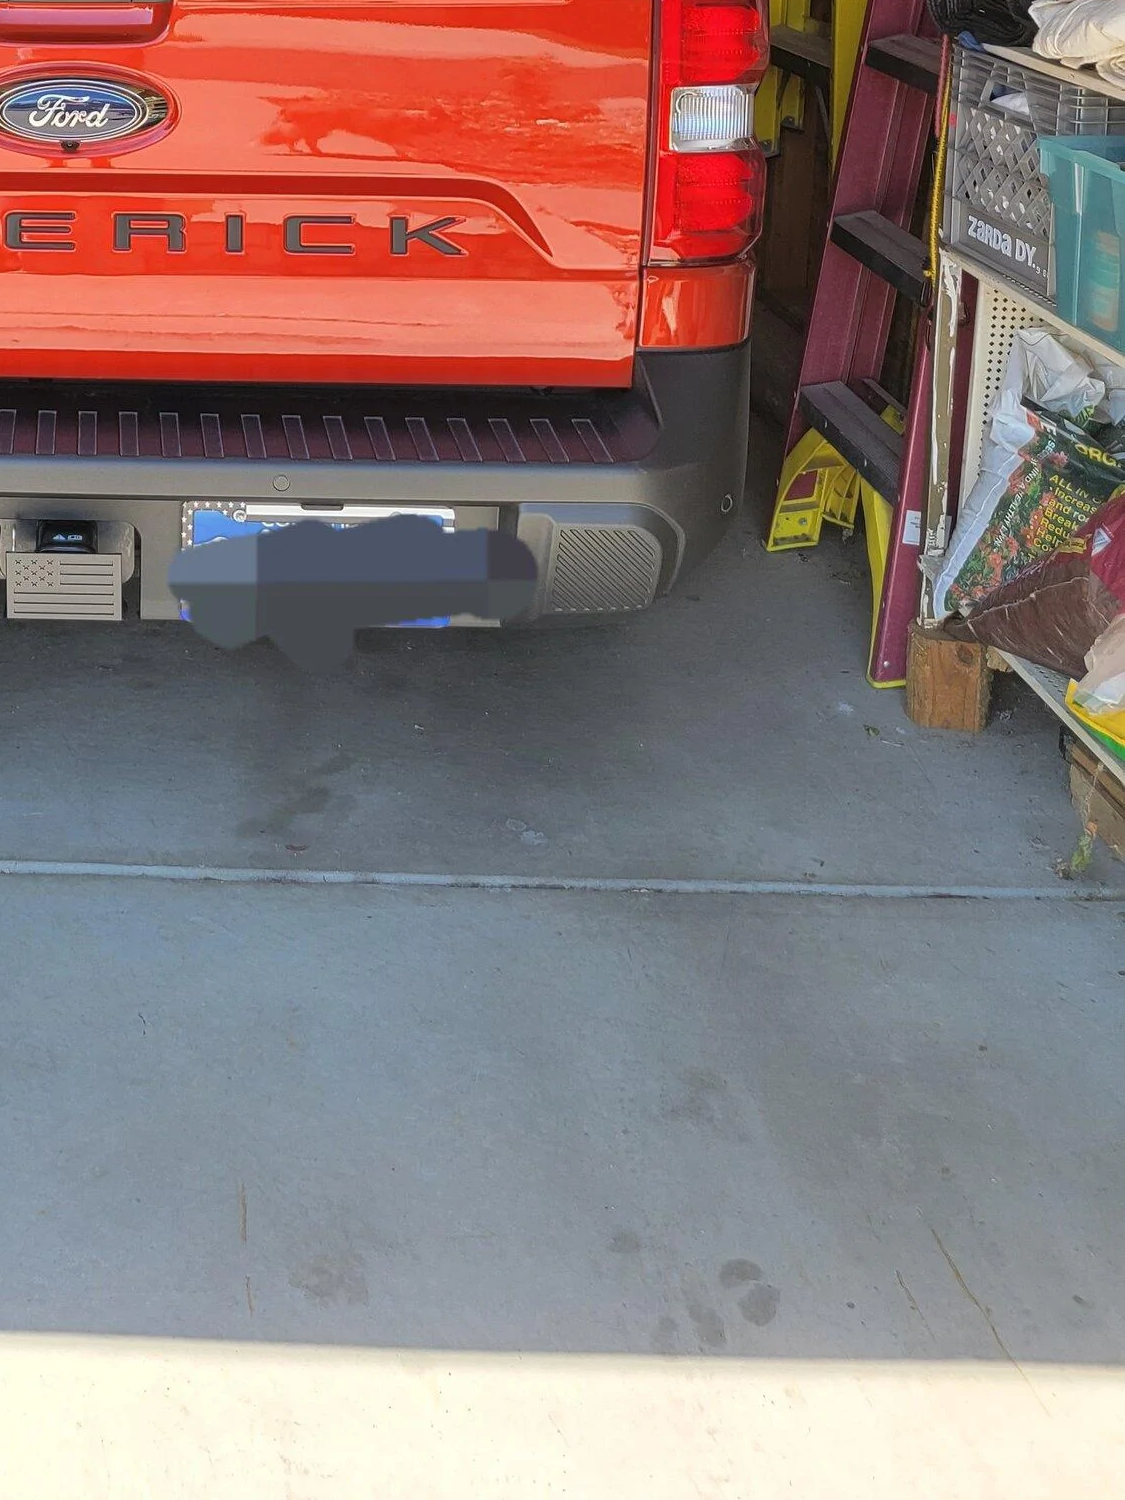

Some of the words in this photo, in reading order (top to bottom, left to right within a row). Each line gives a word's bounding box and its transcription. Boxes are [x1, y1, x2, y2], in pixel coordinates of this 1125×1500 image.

[28, 94, 111, 129] Ford
[1049, 475, 1073, 492] ALL
[1048, 498, 1071, 514] and
[1034, 537, 1052, 552] Co
